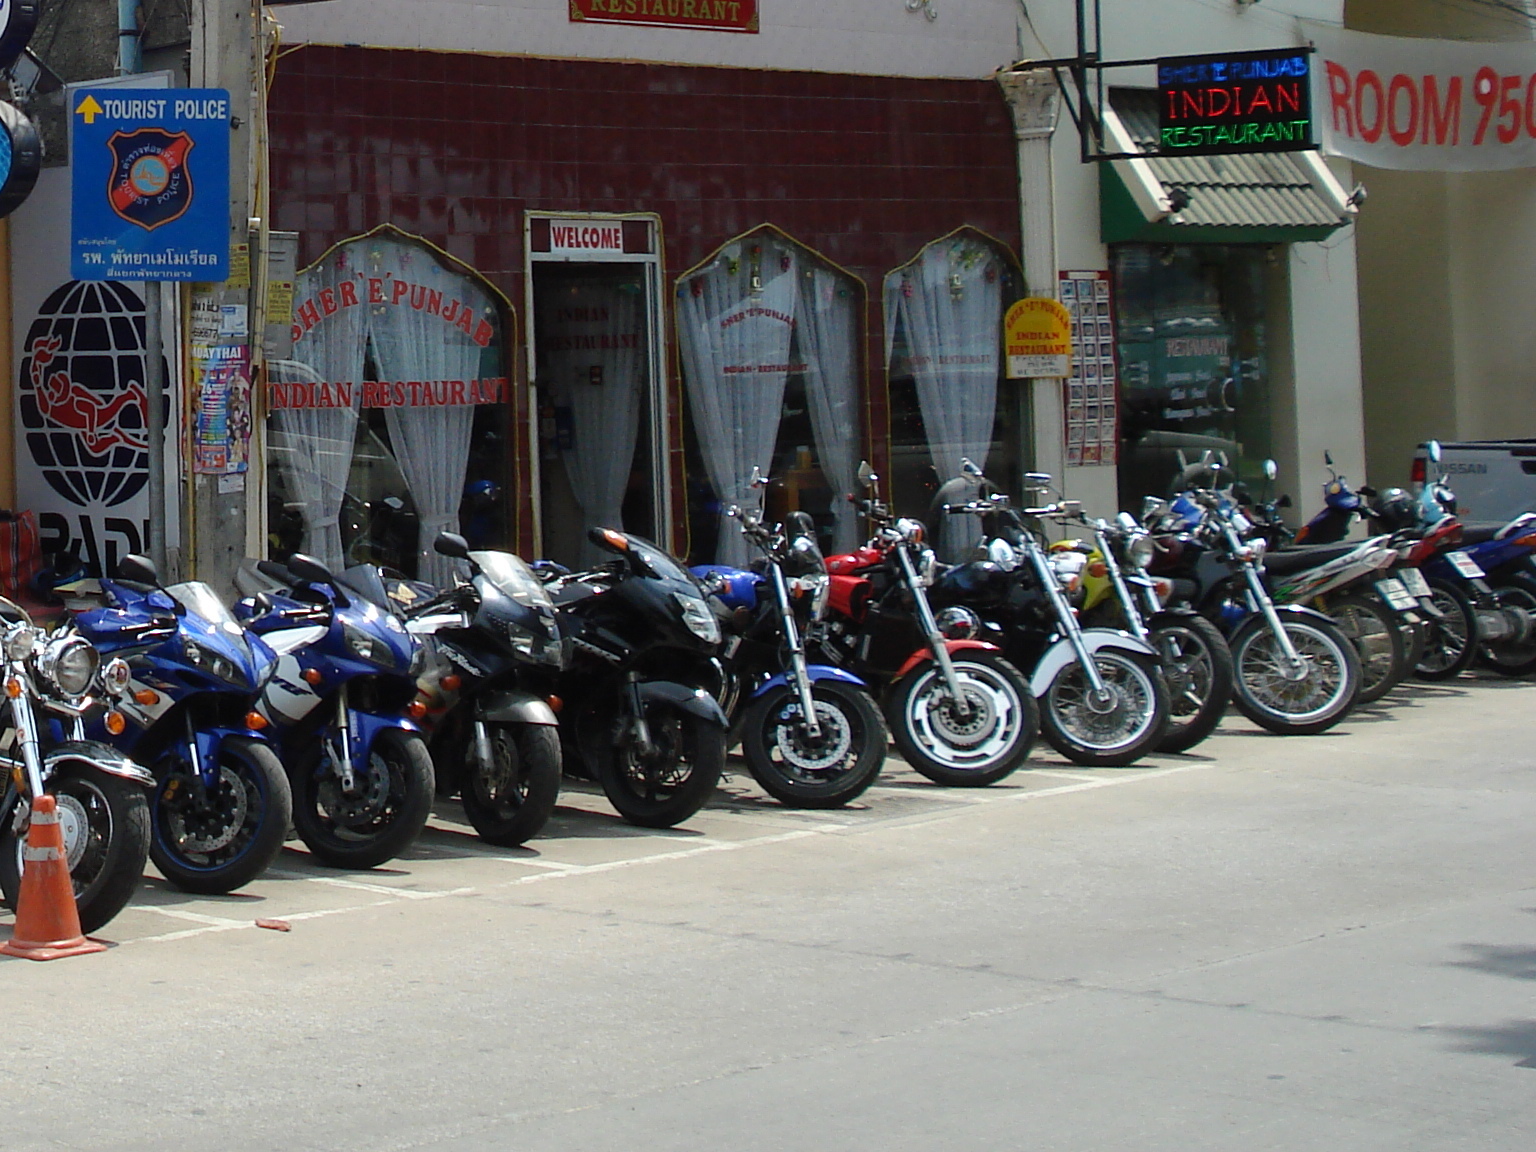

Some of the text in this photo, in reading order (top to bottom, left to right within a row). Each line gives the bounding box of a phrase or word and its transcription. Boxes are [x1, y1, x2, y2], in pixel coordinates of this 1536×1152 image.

[103, 100, 227, 119] TOURIST POLICE
[1167, 83, 1301, 120] INDIAN
[1325, 59, 1462, 146] ROOM
[1160, 120, 1310, 148] RESTAURANT
[553, 225, 621, 250] WELCOME
[391, 279, 494, 347] PUNJAB
[216, 347, 241, 359] THAI
